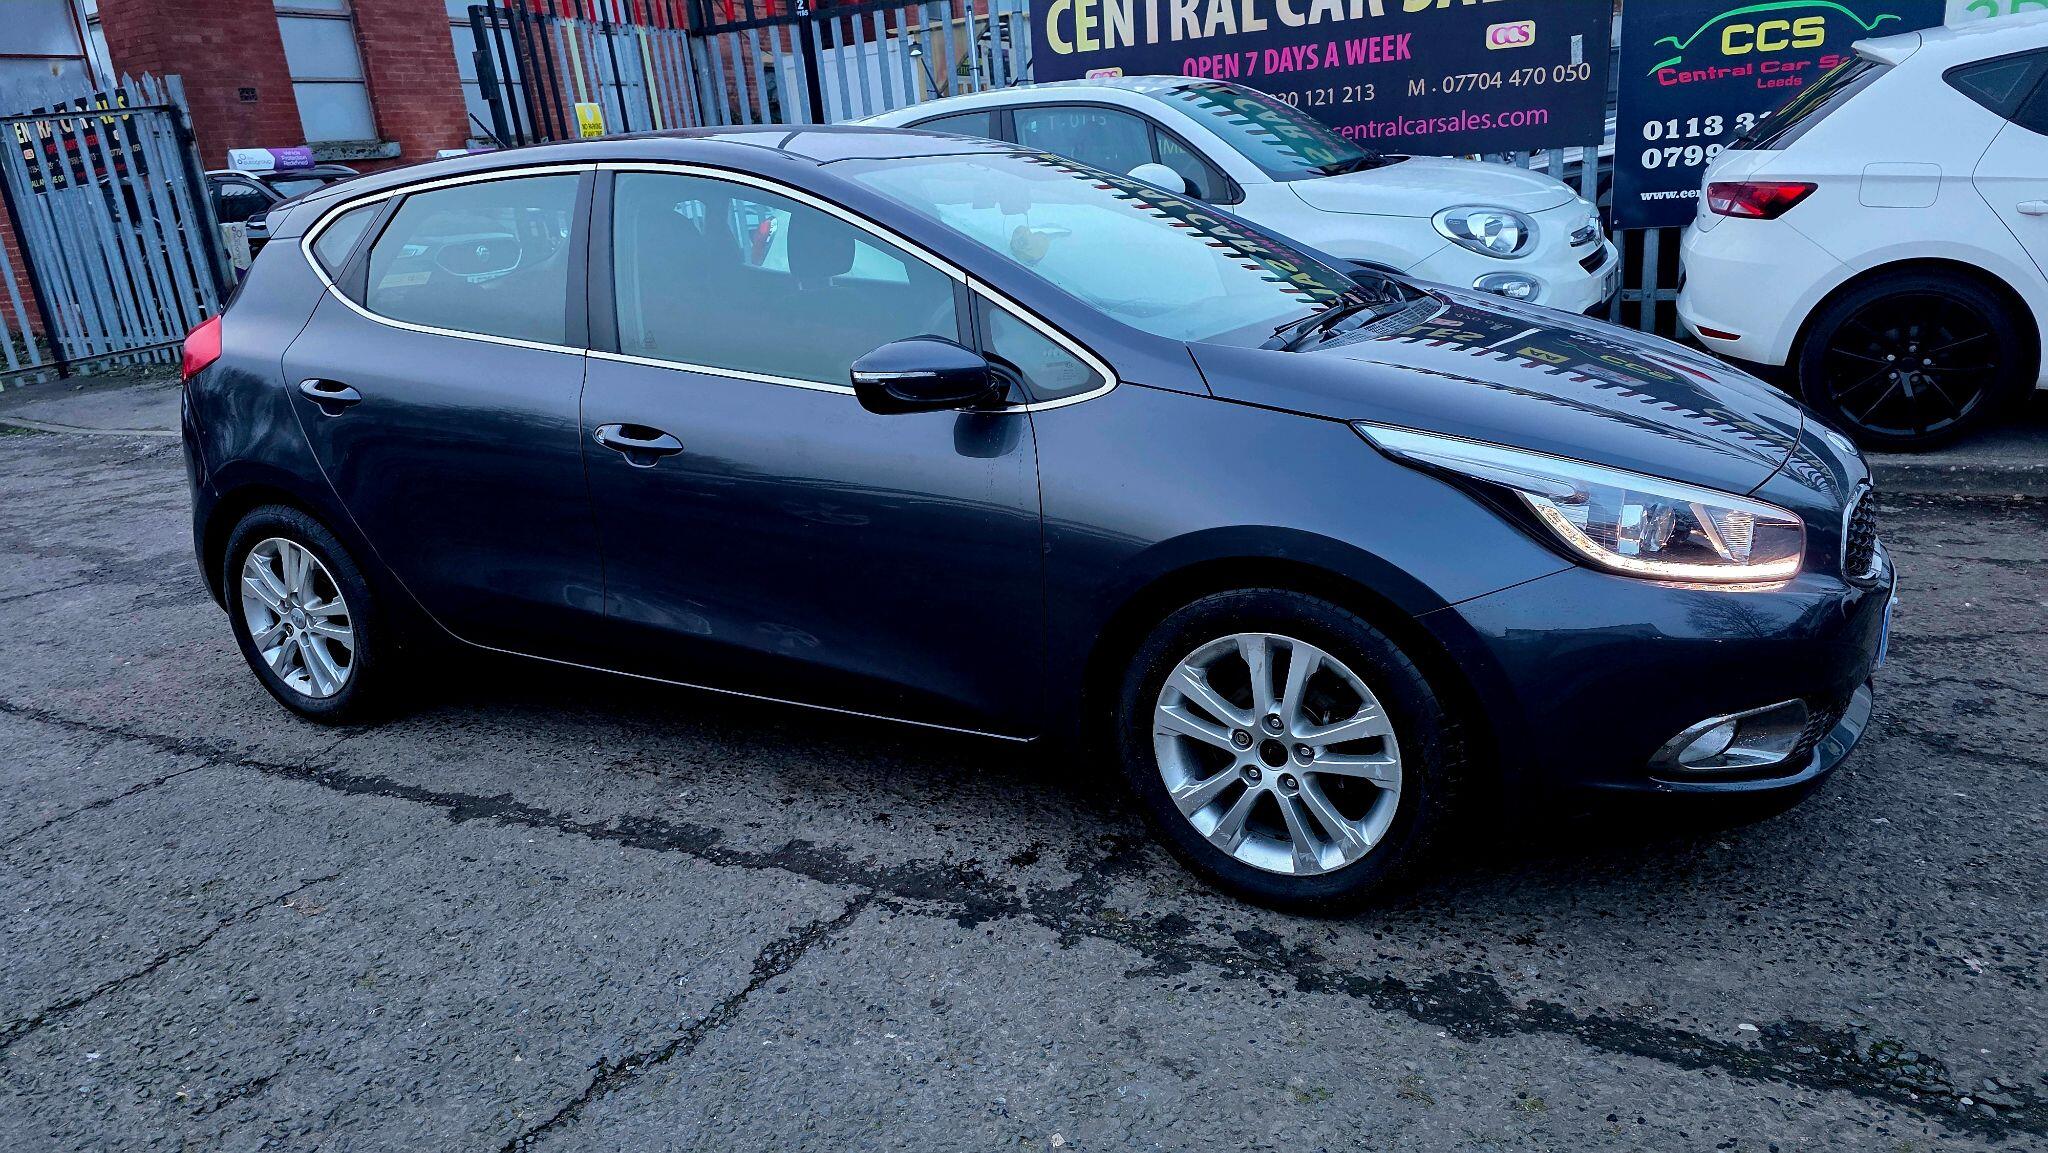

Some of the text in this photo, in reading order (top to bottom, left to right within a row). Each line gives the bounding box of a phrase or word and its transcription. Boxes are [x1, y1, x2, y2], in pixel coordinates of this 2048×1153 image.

[1046, 0, 1268, 54] CENTRAL
[1491, 24, 1531, 46] CCS
[1722, 16, 1826, 56] CCS
[1183, 32, 1412, 79] OPEN 7 DAYS A WEEK
[1408, 79, 1425, 97] M
[1442, 72, 1502, 94] 07704
[1508, 67, 1546, 87] 470
[1552, 62, 1591, 83] 050
[1657, 63, 1752, 86] Central
[1760, 60, 1811, 74] Car
[1757, 75, 1803, 89] Leeds
[1269, 84, 1375, 107] 30 121 213
[1643, 111, 1773, 141] 0113 3
